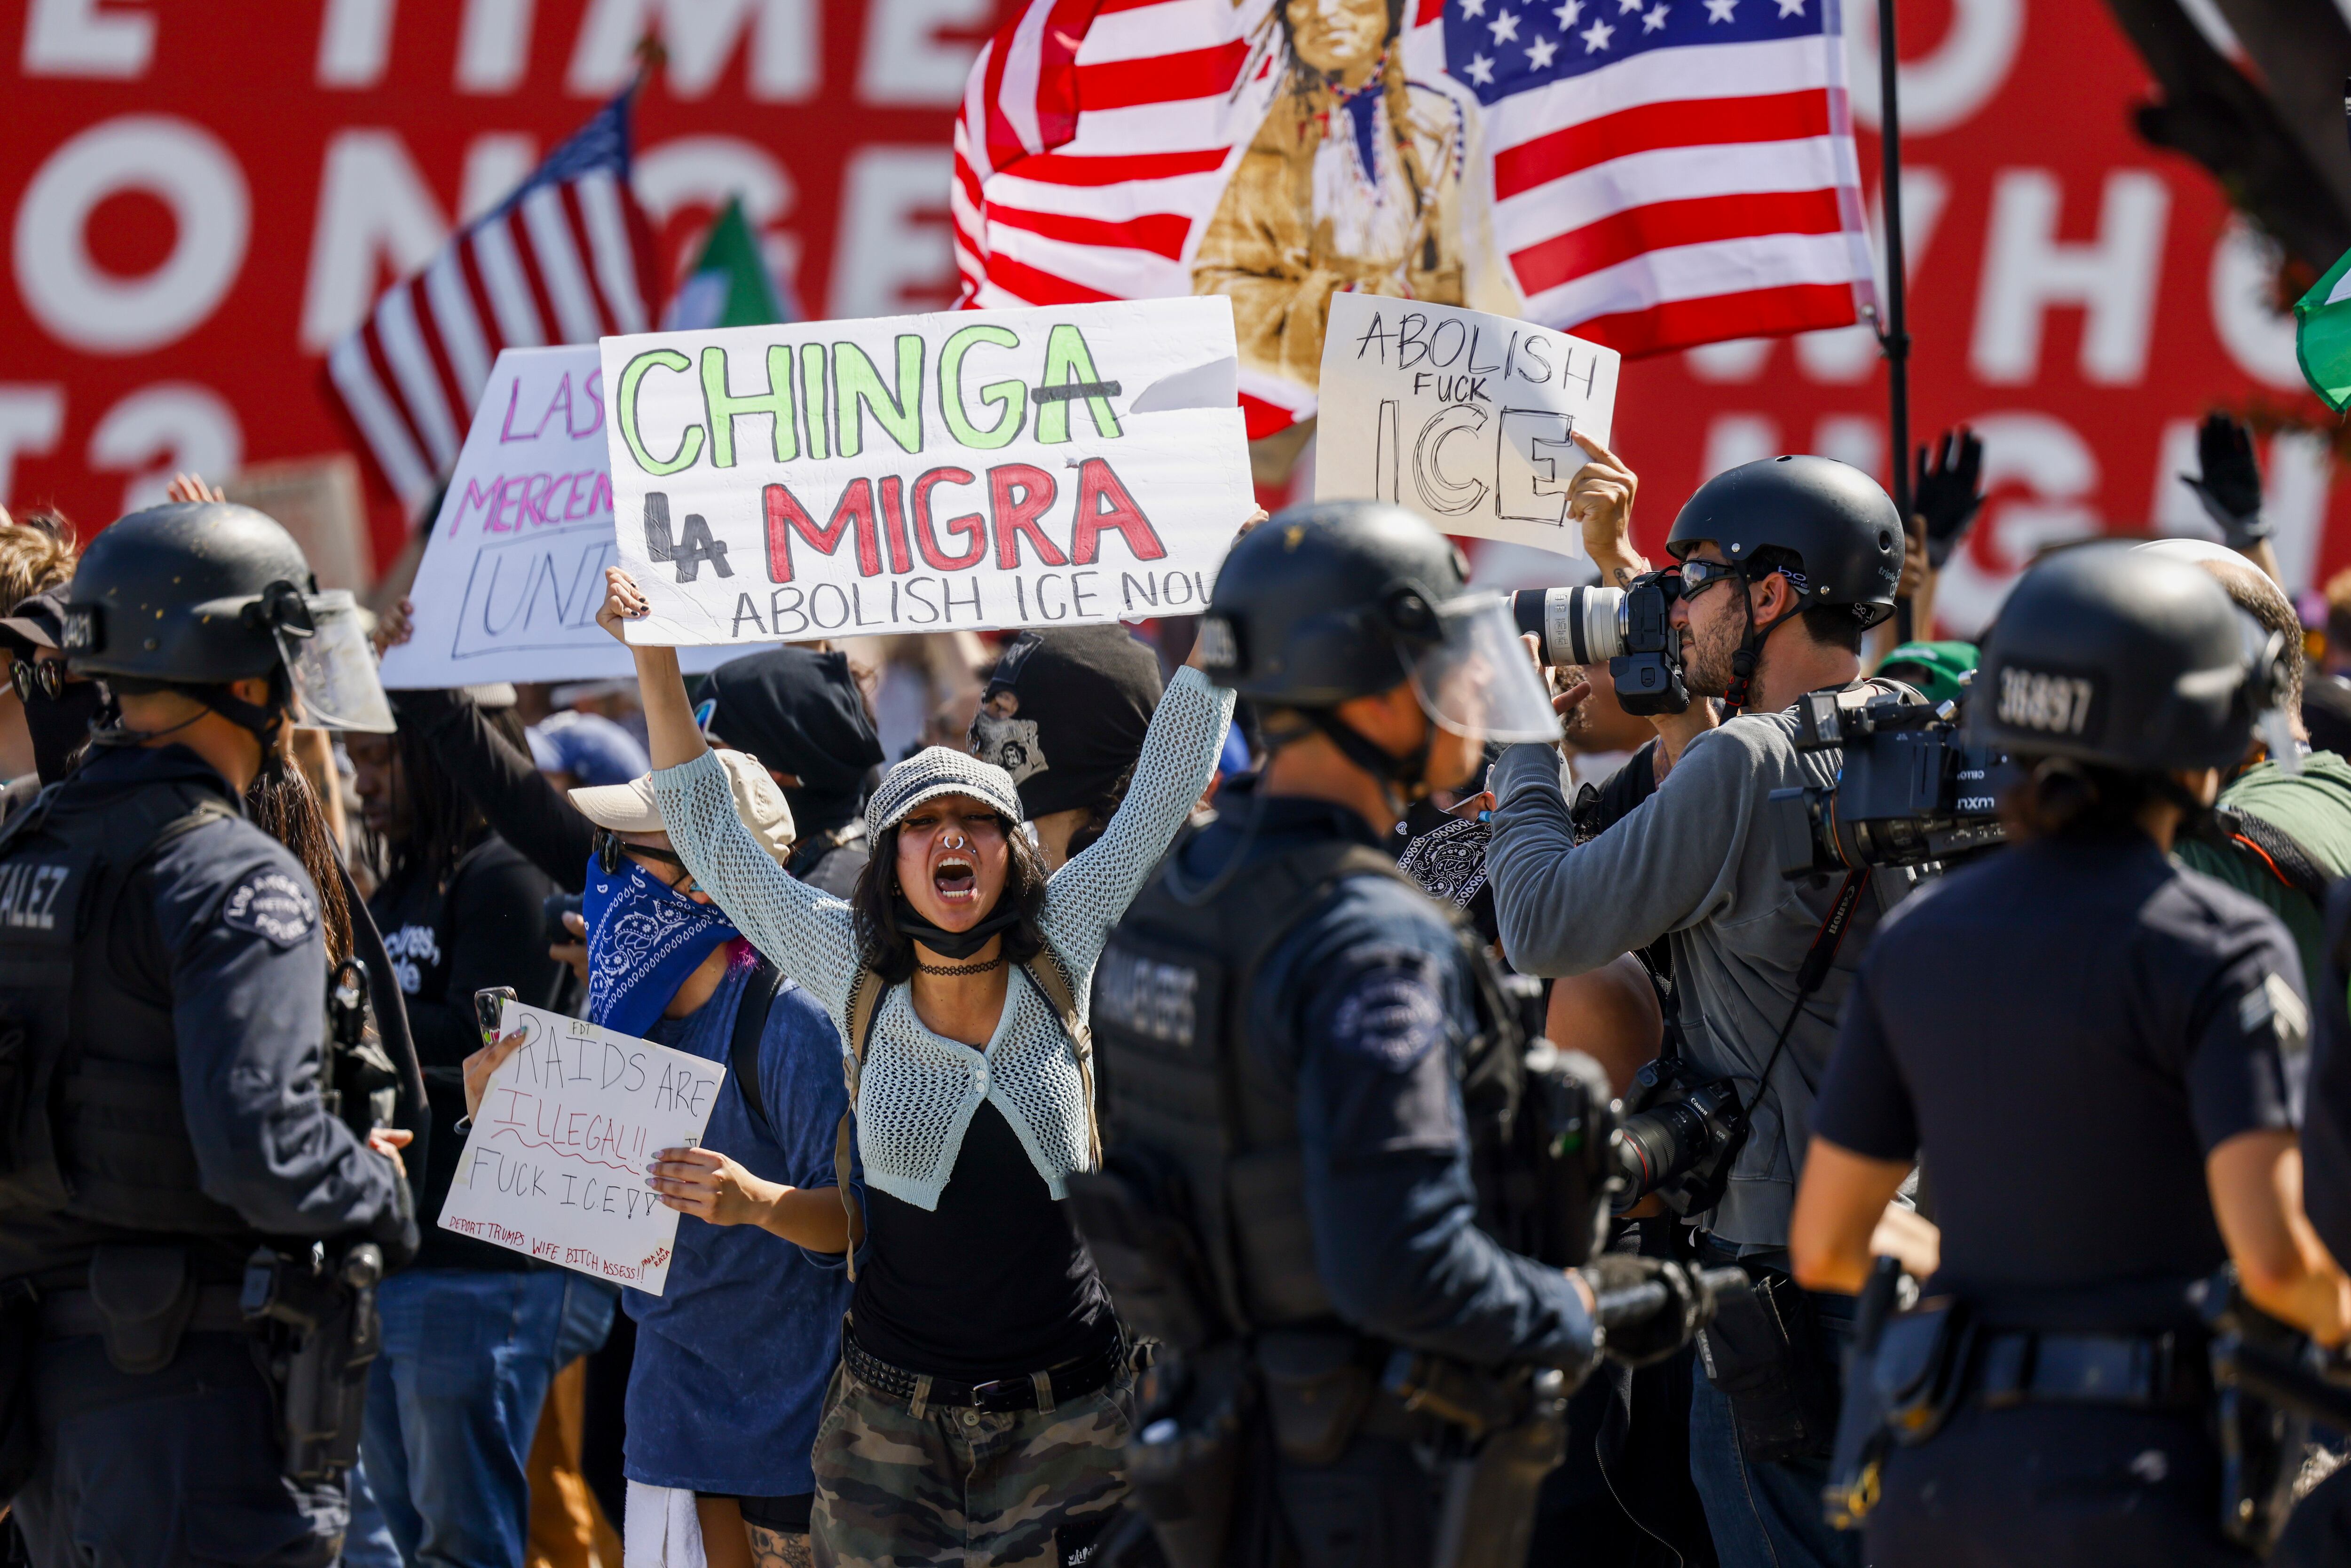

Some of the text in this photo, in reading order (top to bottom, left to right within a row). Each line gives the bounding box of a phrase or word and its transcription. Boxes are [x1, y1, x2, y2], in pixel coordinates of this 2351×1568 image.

[1356, 311, 1597, 401] ABOLISH
[616, 323, 1124, 476] CHINGA
[1414, 372, 1491, 402] FUCK
[1376, 400, 1576, 528] ICE
[644, 458, 1168, 584] LA MIGRA
[1878, 566, 1896, 582] triple
[731, 576, 984, 638] ABOLISH
[1015, 572, 1105, 622] ICE
[1829, 885, 1855, 934] Canon
[572, 1021, 593, 1035] FDT
[516, 1013, 715, 1117] RAIDS ARE
[493, 1088, 647, 1166] ILLEGAL!!
[1691, 1097, 1708, 1116] Canon
[1716, 1130, 1726, 1139] EOS
[469, 1146, 547, 1197] FUCK
[449, 1215, 646, 1284] DEPORT TRUMPS WIFE BITCH ASSESS!!
[654, 1250, 670, 1268] RAZA
[656, 1247, 665, 1256] LA
